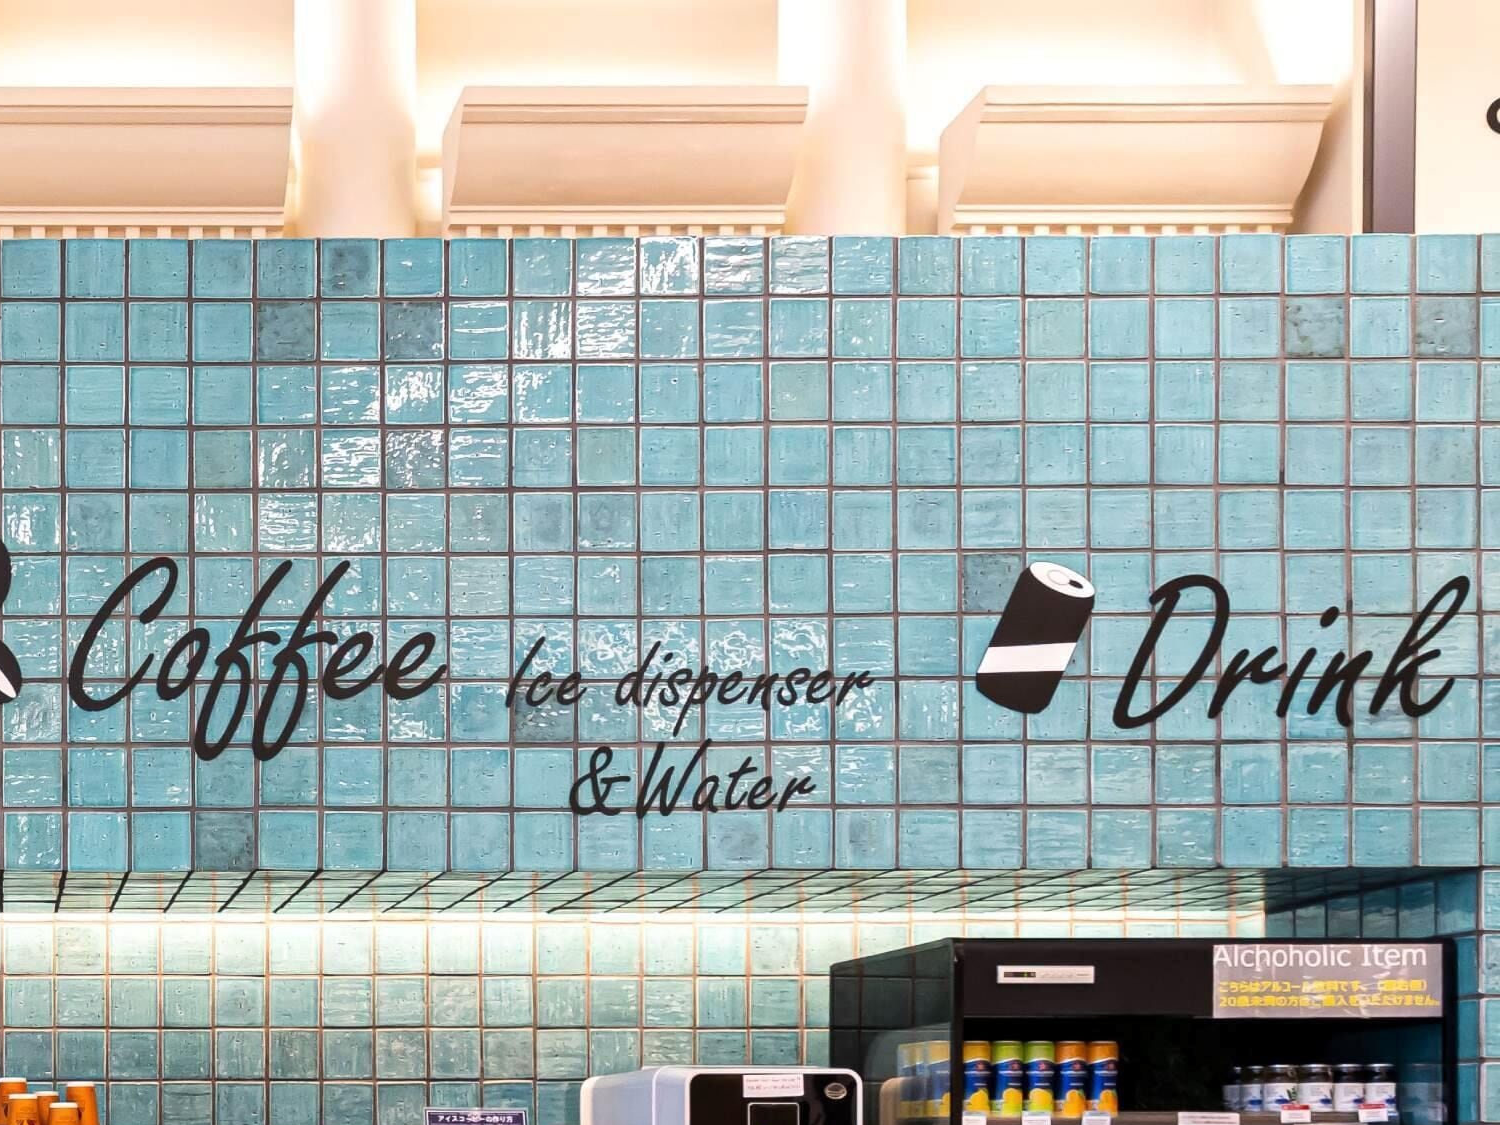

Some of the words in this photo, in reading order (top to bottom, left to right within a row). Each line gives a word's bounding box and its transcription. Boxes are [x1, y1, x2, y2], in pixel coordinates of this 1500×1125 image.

[67, 556, 447, 762] Coffee
[505, 641, 585, 708] Ice
[613, 641, 875, 737] dispenser
[1113, 574, 1471, 730] Drink
[1213, 945, 1351, 968] Alchoholic
[1361, 945, 1427, 967] Item
